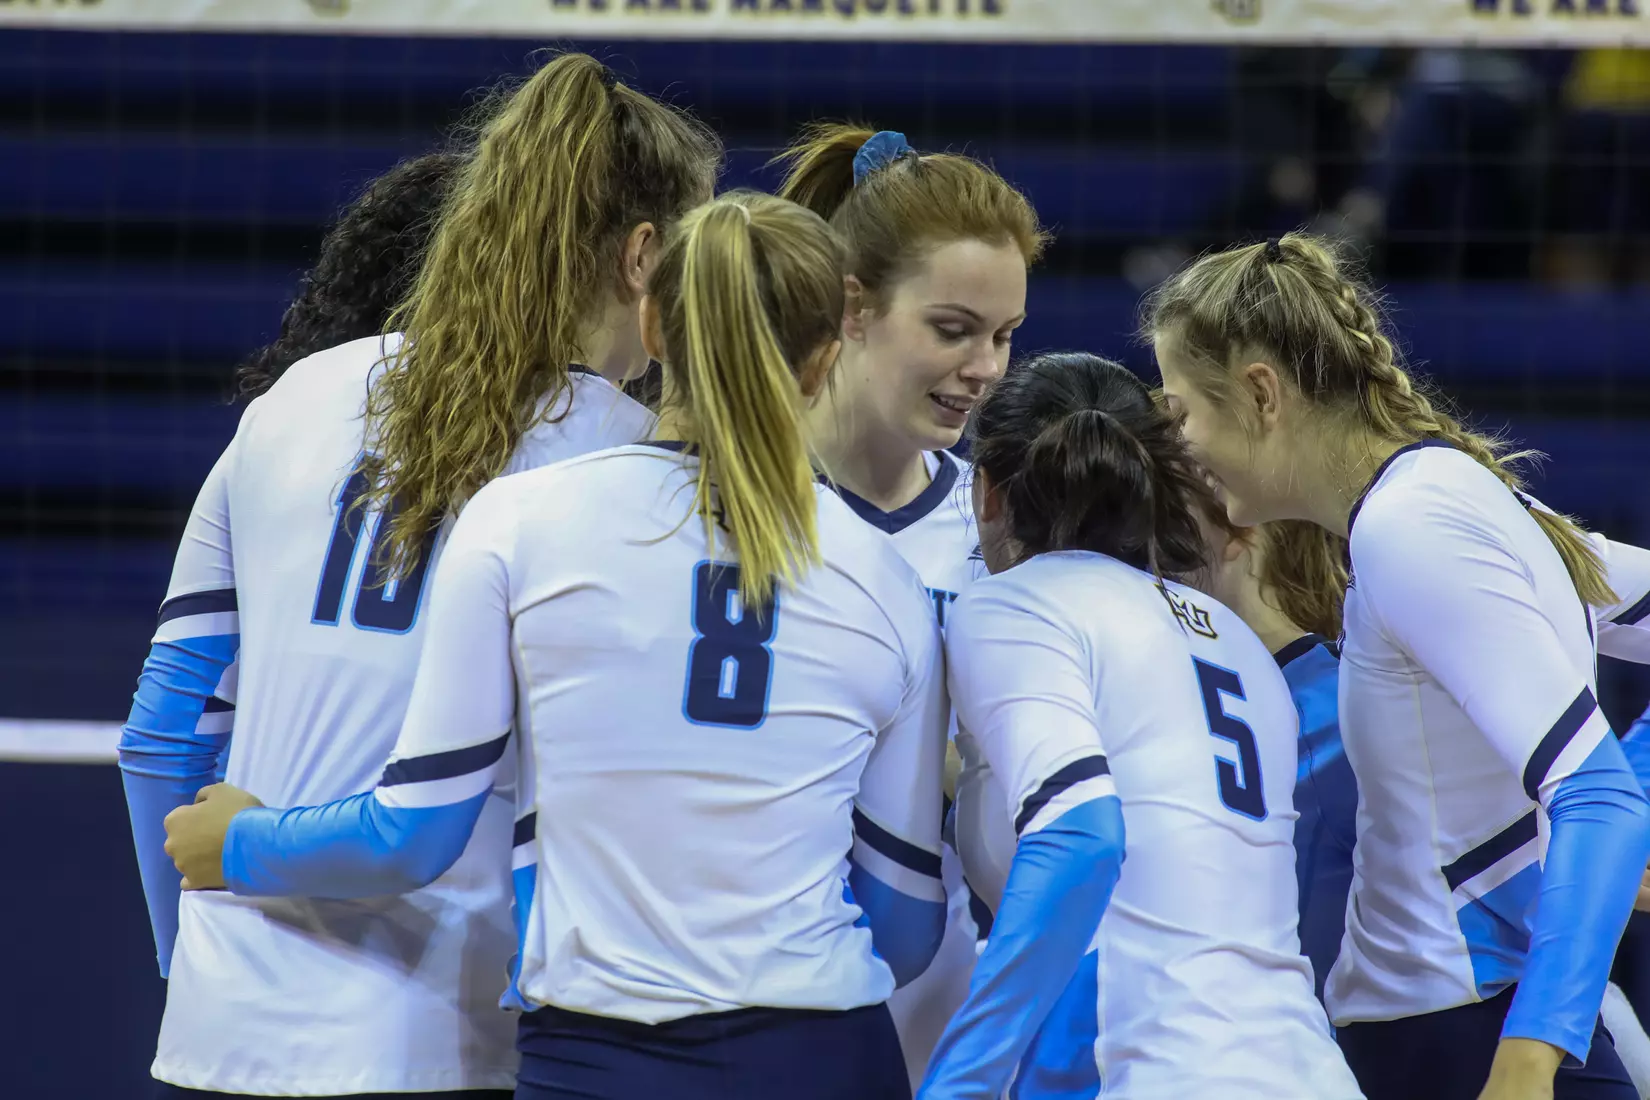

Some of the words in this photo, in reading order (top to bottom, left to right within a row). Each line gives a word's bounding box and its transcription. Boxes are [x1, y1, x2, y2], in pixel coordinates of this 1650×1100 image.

[310, 449, 447, 635] 10
[681, 559, 780, 731] 8
[1190, 653, 1269, 822] 5
